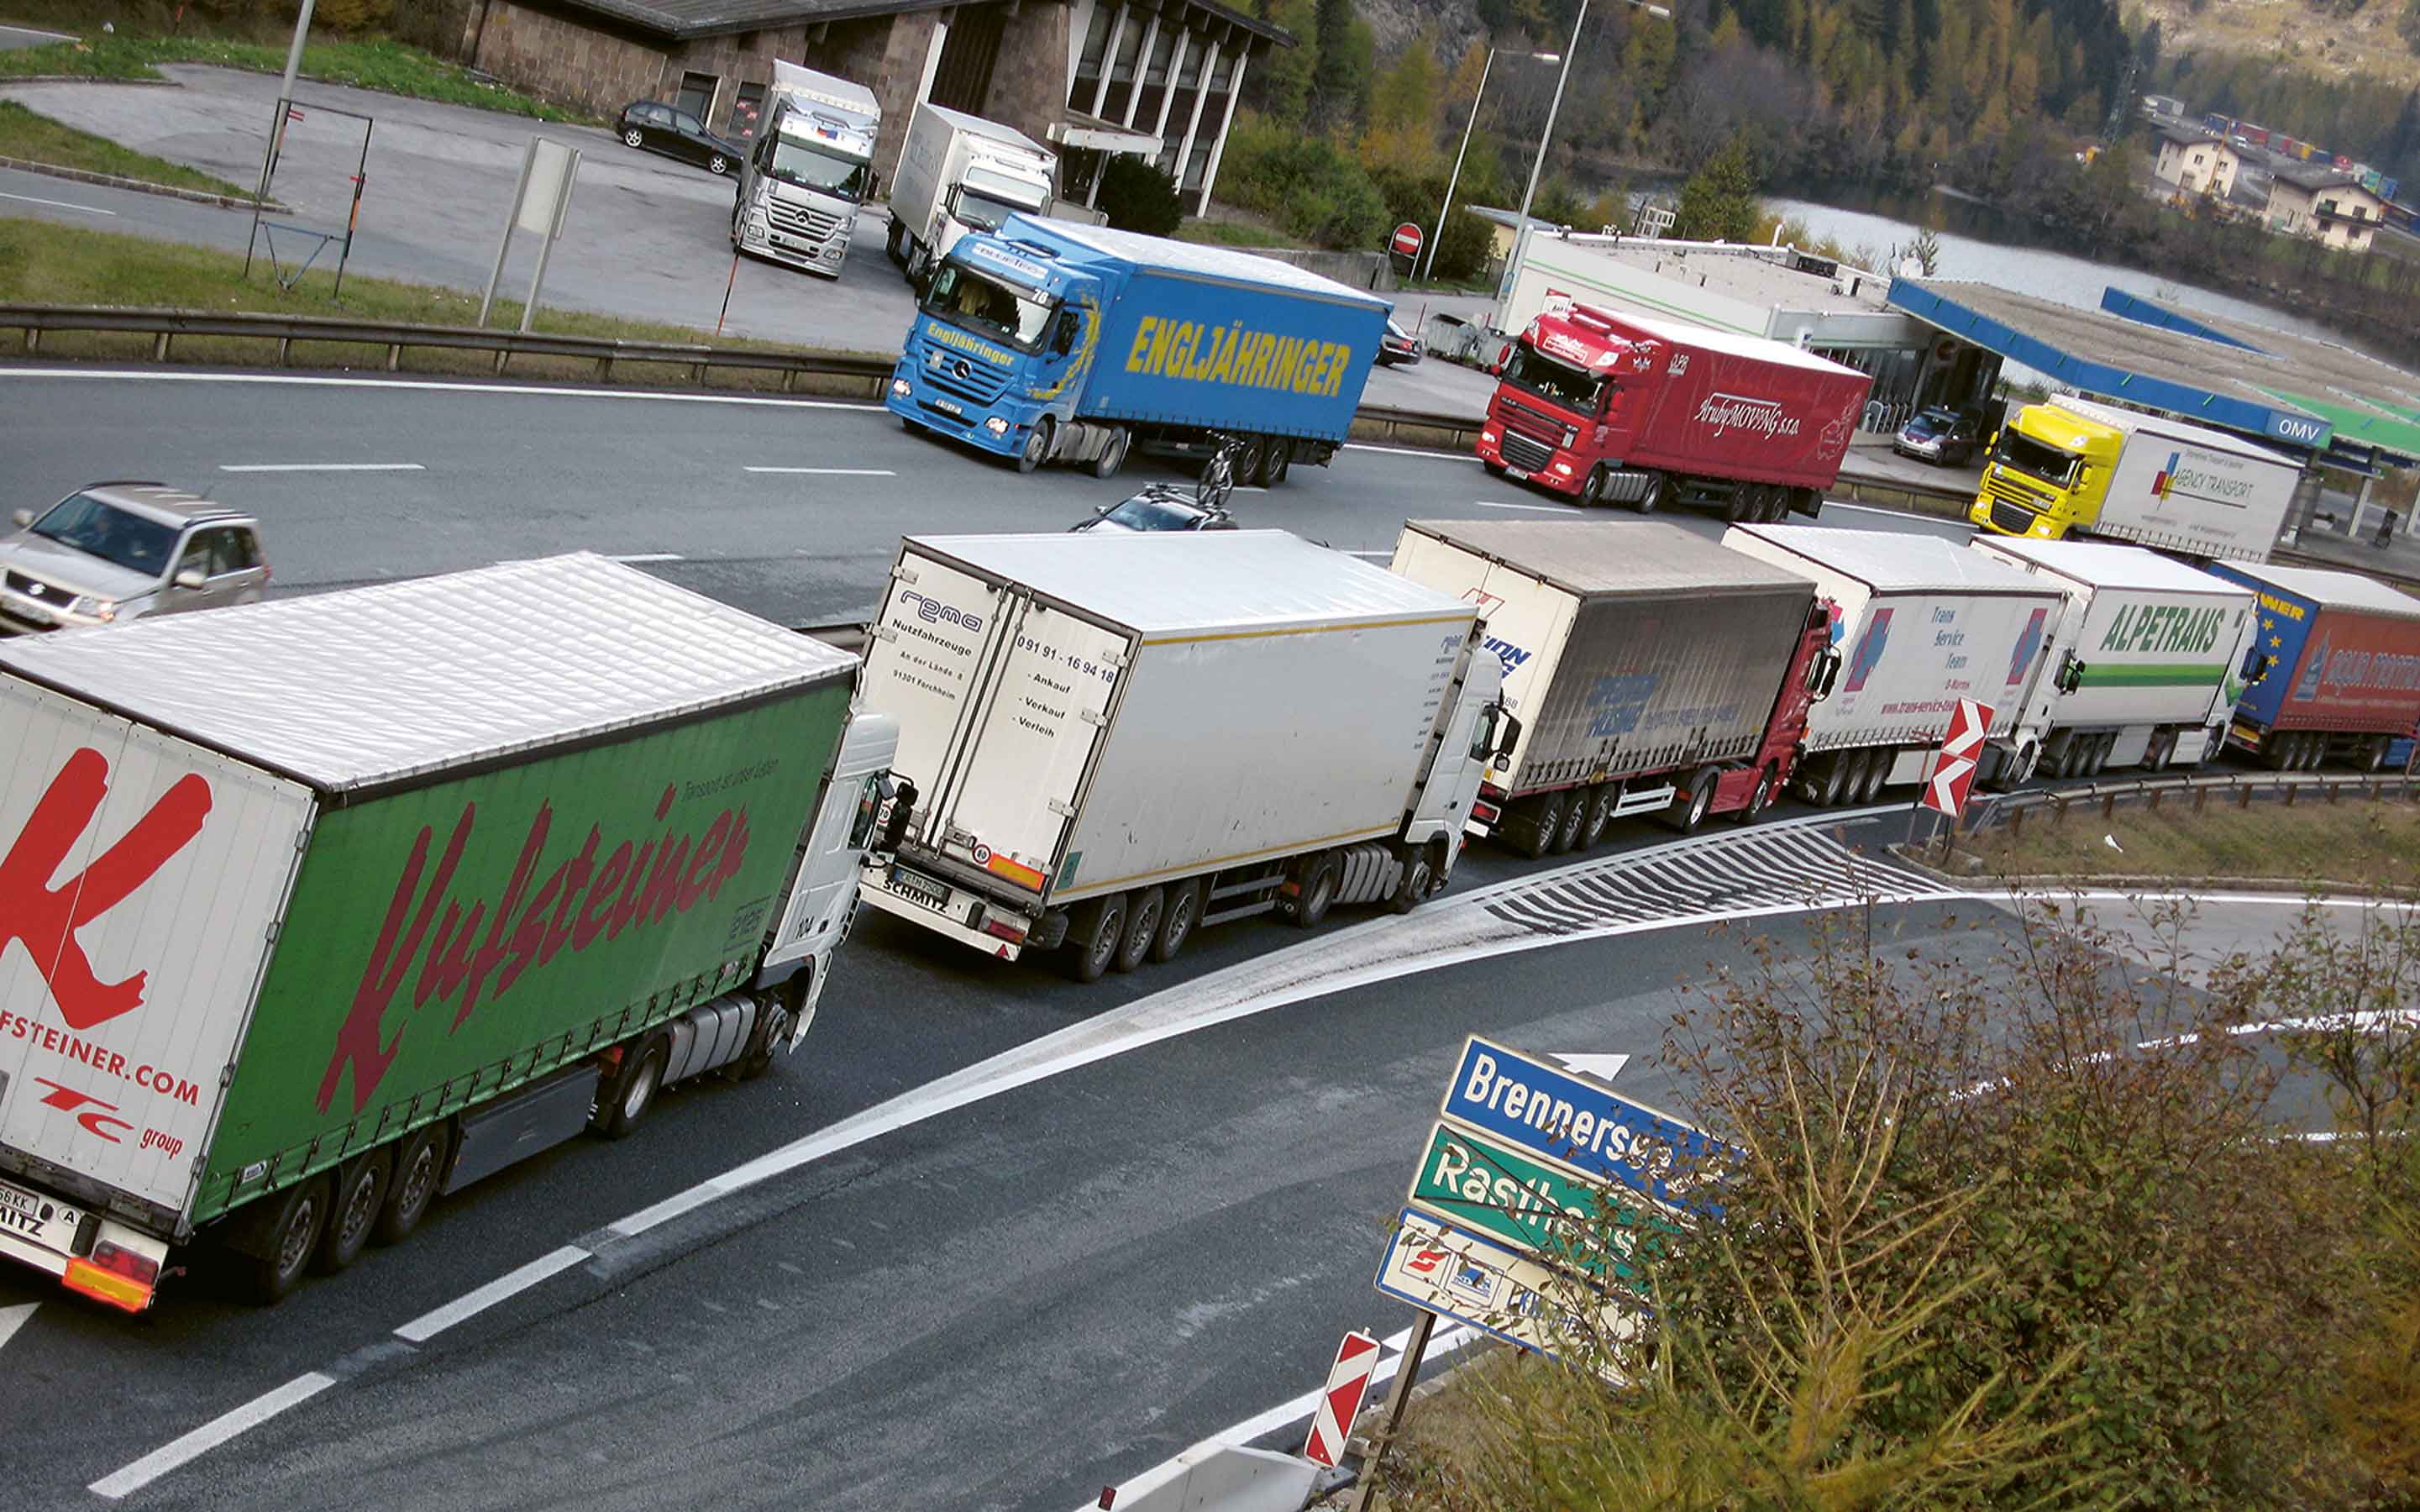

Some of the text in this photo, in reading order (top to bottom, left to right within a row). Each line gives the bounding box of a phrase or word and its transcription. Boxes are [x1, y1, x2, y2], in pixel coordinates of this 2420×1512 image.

[927, 322, 1015, 366] Engljähringer
[1126, 316, 1352, 399] ENGLJÄHRINGER
[2278, 418, 2321, 442] OMV
[900, 590, 983, 633] rema
[1932, 606, 1956, 624] Trans
[892, 618, 972, 658] Nutzfahrzeuge
[1934, 630, 1966, 647] Service
[2098, 604, 2227, 654] ALPETRANS
[1033, 673, 1071, 695] Ankauf
[1068, 655, 1081, 671] 16
[1083, 660, 1096, 676] 94
[1100, 668, 1114, 684] 18
[1026, 696, 1066, 720] Verkauf
[1019, 716, 1055, 738] Verleih
[882, 879, 949, 914] SCHMITZ
[314, 780, 751, 1116] Kufsteiner
[140, 1126, 183, 1160] group
[63, 1210, 76, 1224] A
